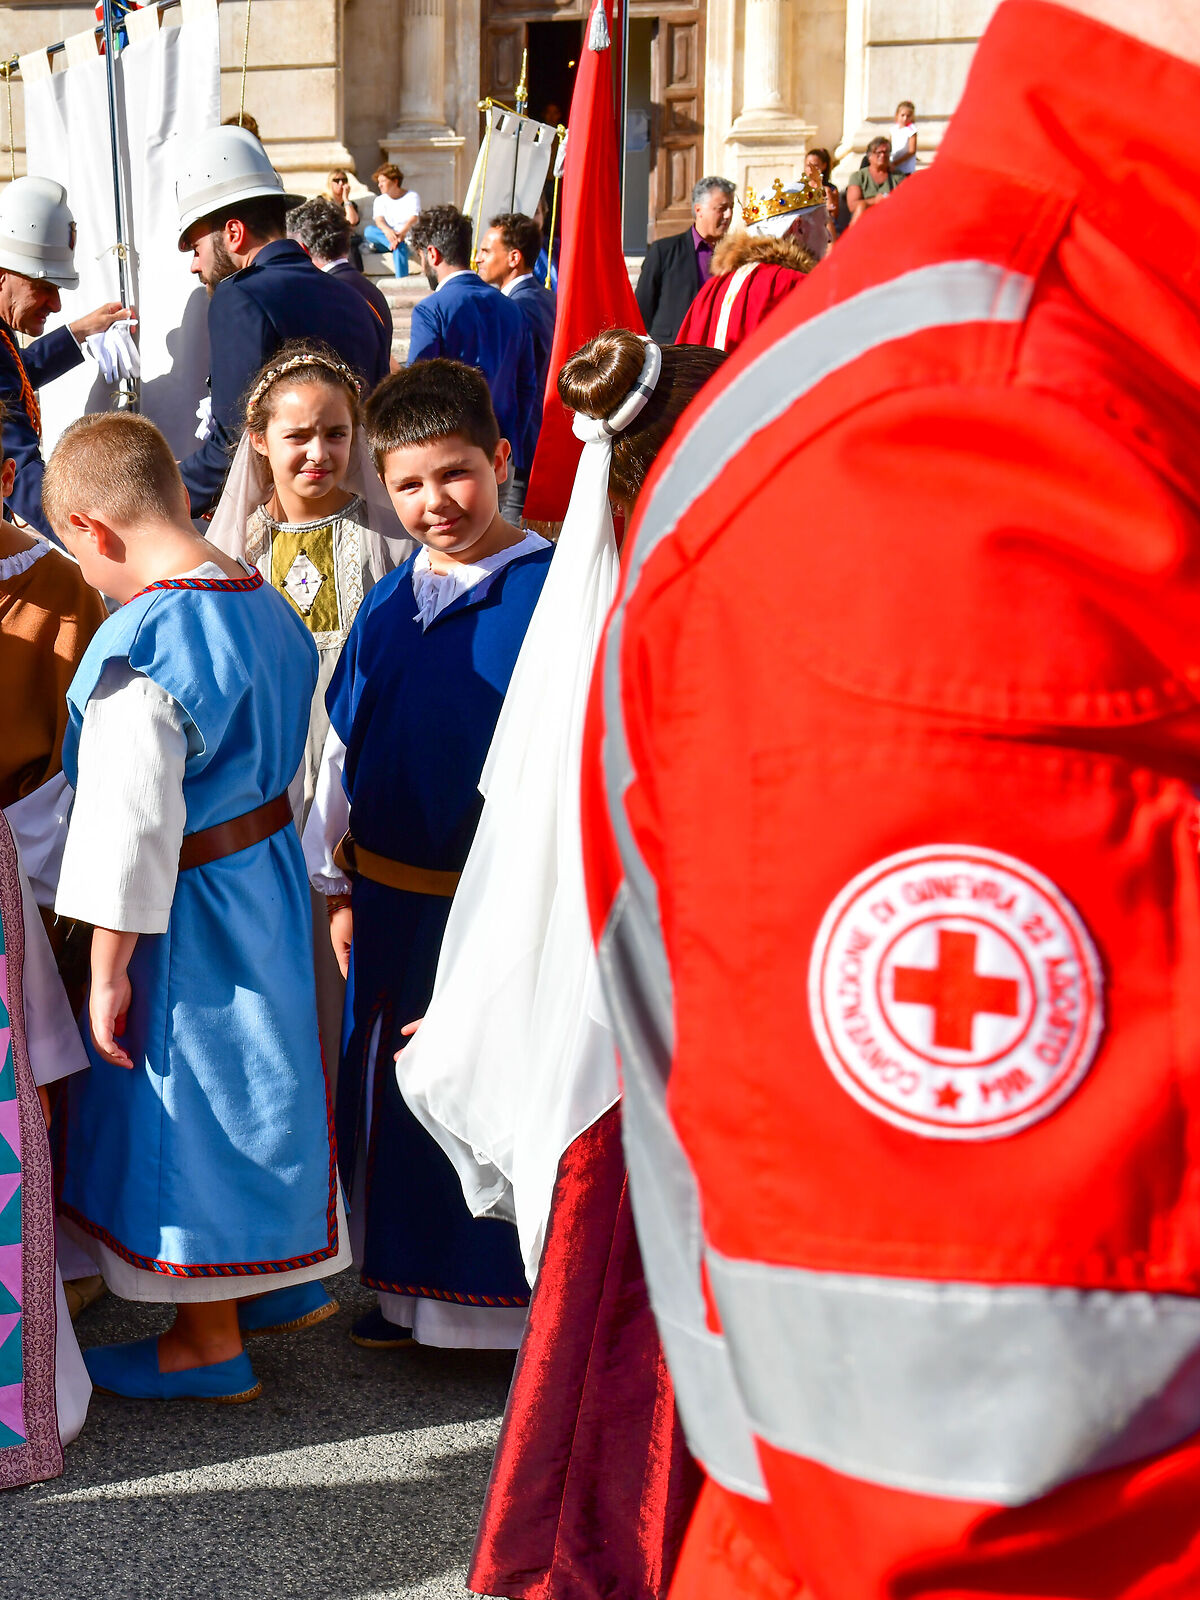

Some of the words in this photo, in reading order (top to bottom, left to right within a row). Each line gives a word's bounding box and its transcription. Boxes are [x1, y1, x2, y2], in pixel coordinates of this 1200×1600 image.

[869, 897, 896, 924] DI
[902, 874, 1019, 918] GINEVRA
[1022, 913, 1055, 946] 22
